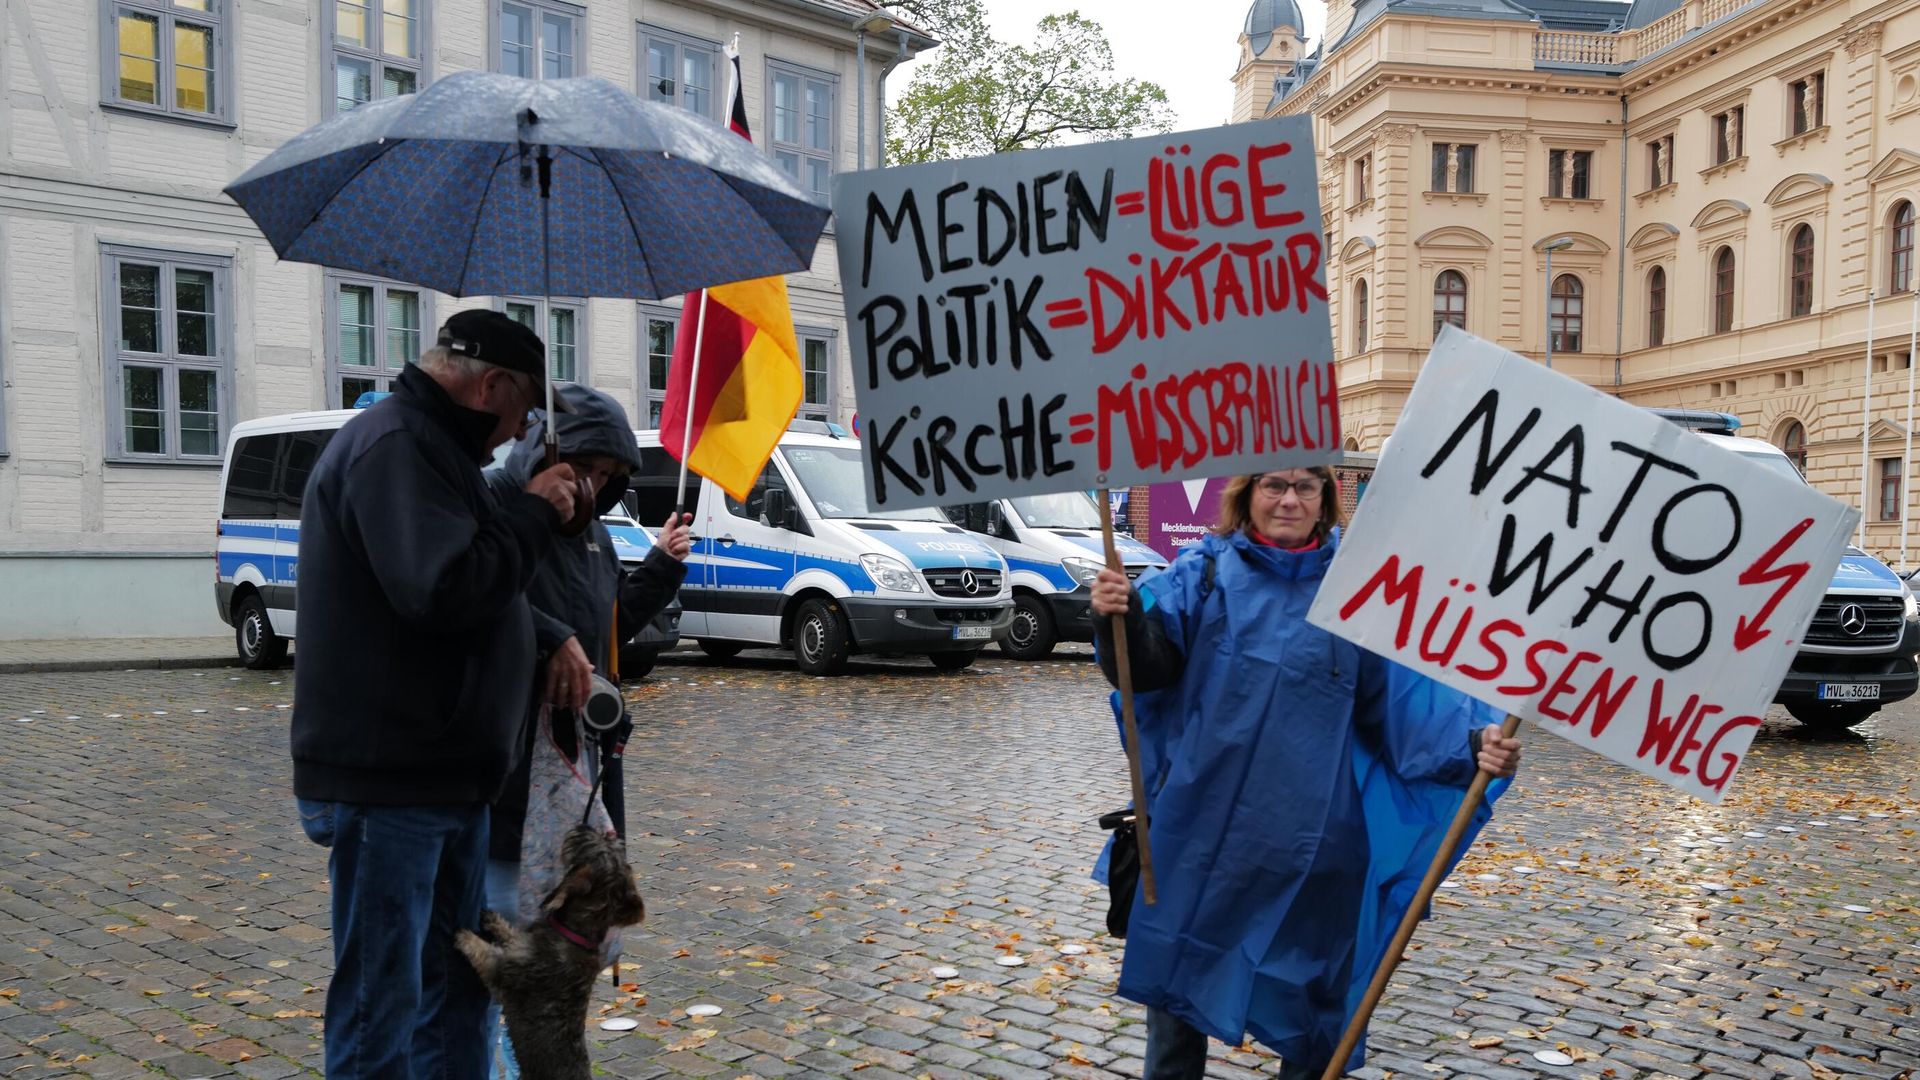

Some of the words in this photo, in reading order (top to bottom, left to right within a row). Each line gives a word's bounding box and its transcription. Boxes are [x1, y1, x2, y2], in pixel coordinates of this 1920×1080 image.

[916, 541, 979, 553] POLIZEI
[1420, 389, 1742, 575] NATO
[1487, 514, 1713, 672] WHO
[1339, 554, 1638, 738] MÜSSEN
[1636, 678, 1762, 792] WEG
[1826, 684, 1845, 698] MVL
[1851, 684, 1879, 698] 36213
